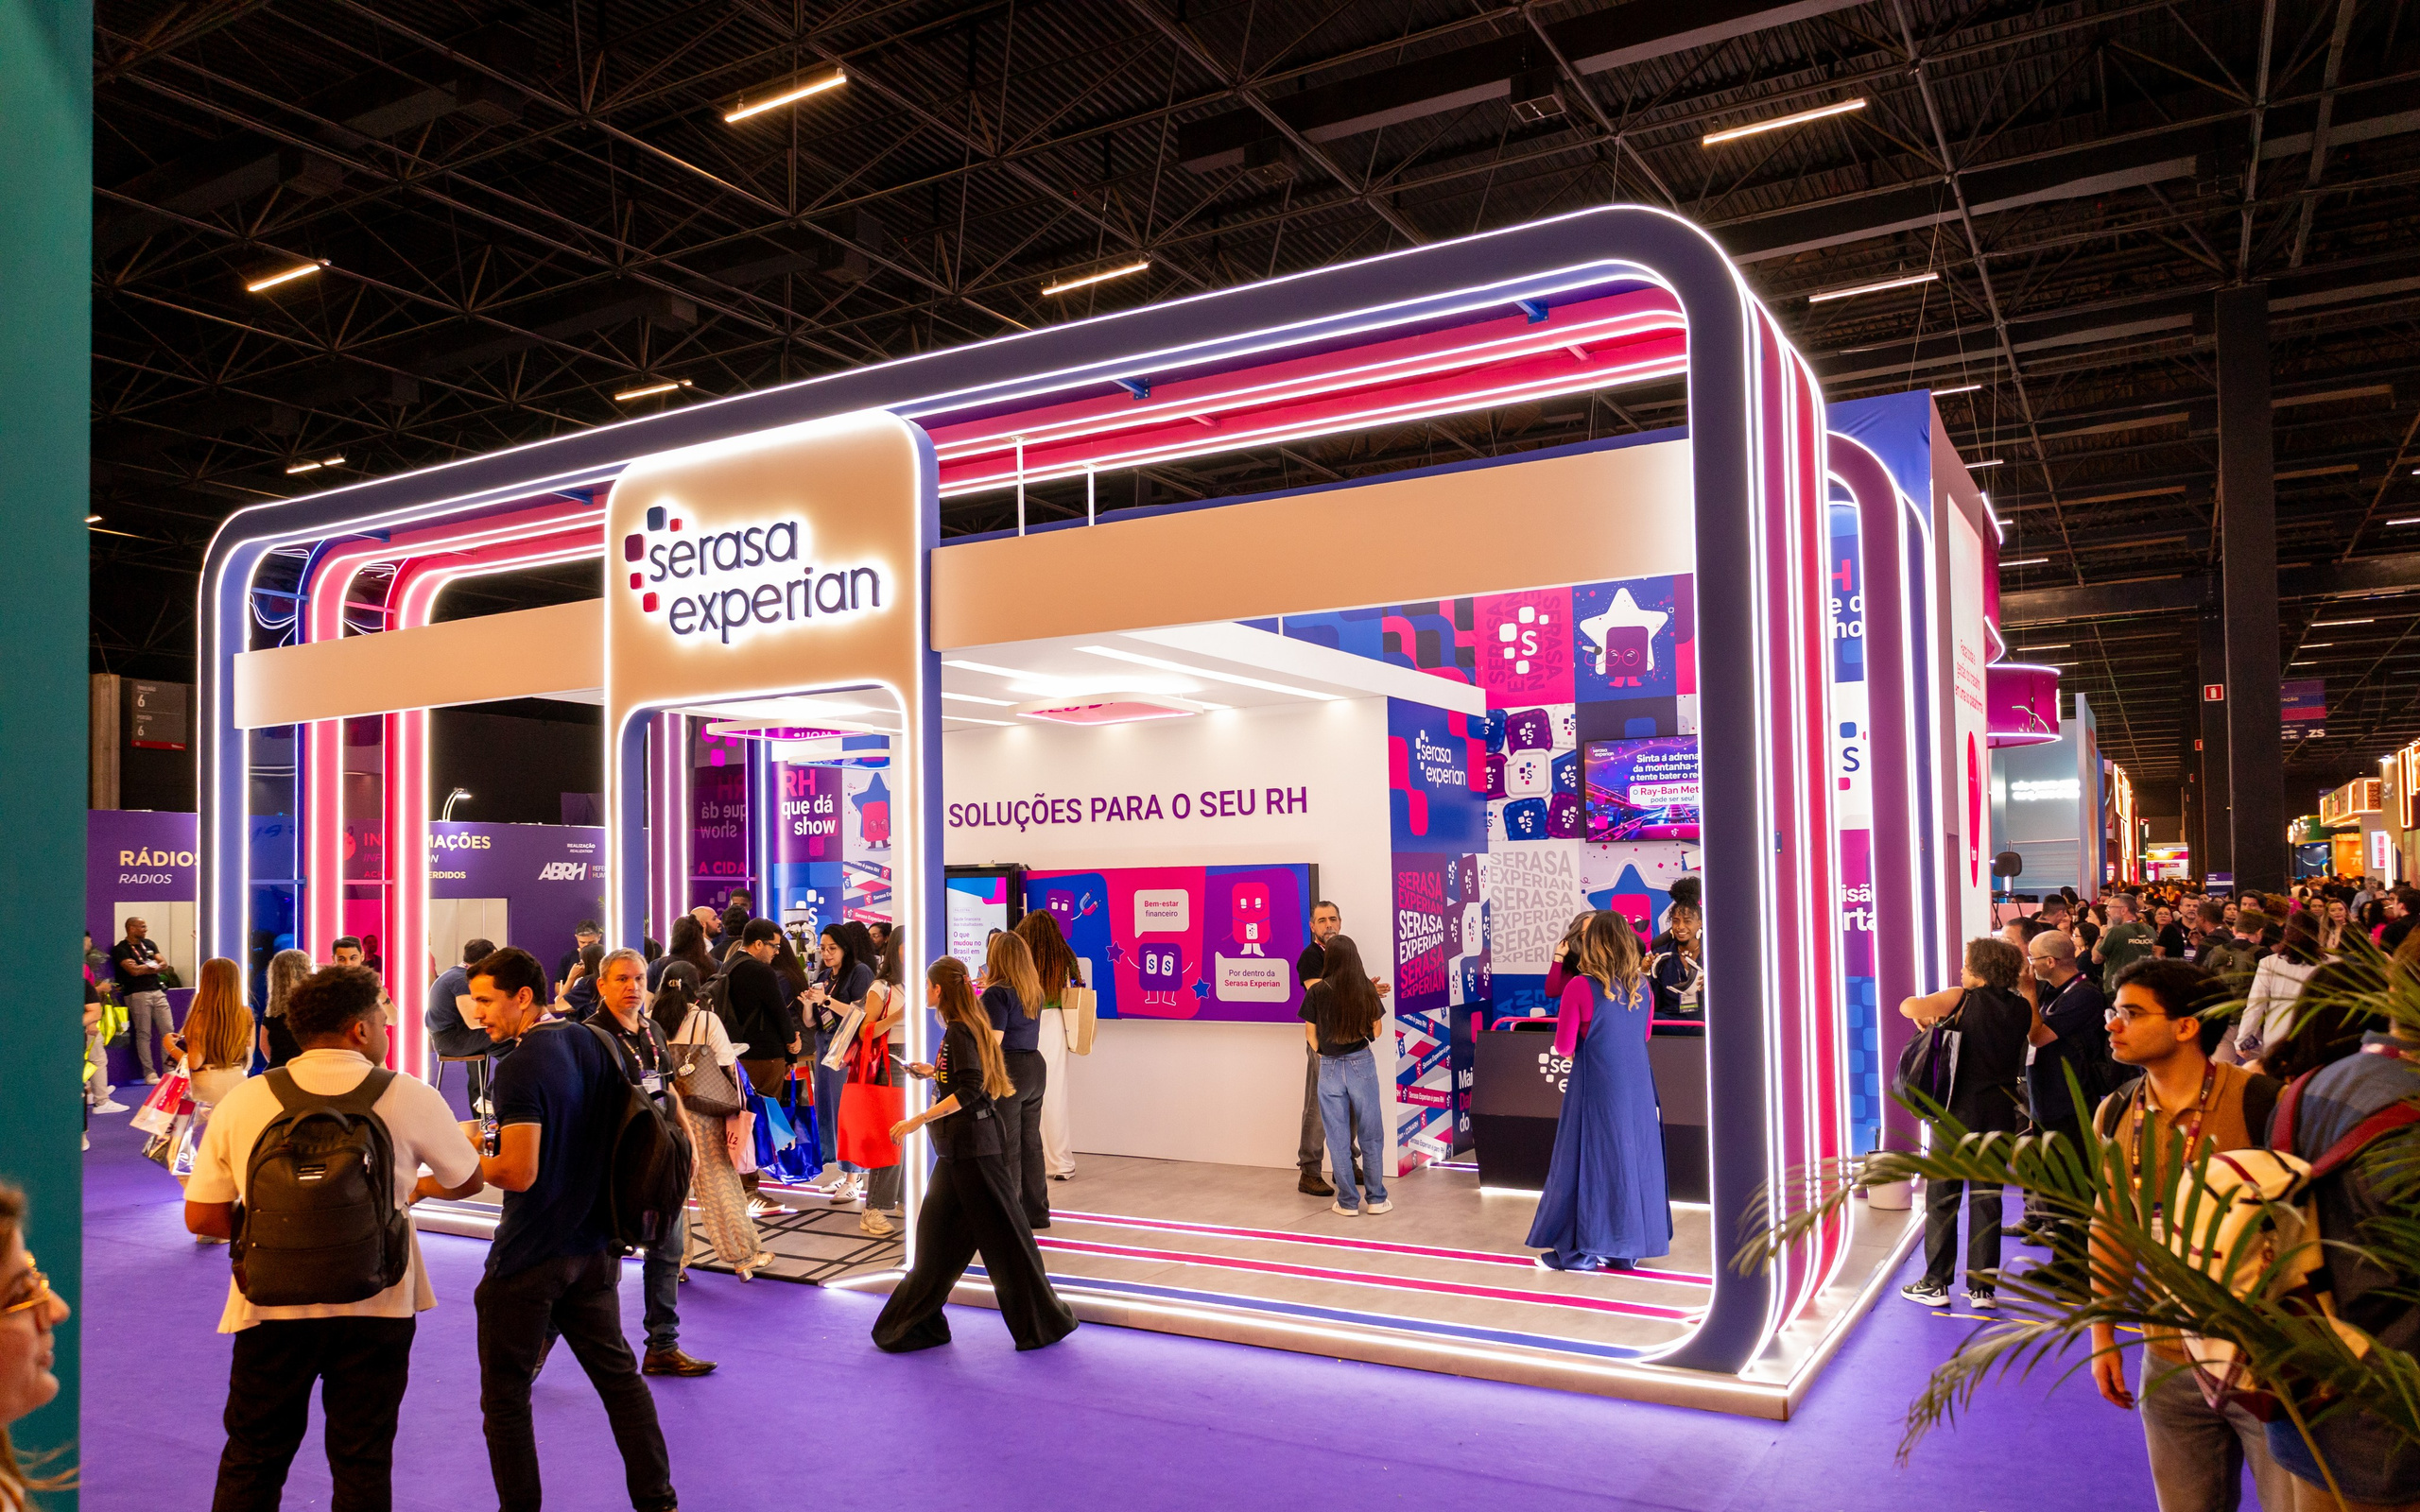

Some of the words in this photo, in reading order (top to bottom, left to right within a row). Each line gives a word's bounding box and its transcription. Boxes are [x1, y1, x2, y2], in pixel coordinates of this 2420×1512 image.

[649, 521, 798, 583] serasa
[669, 567, 880, 644] experian
[137, 694, 146, 708] 6
[137, 725, 145, 736] 6
[1421, 744, 1452, 764] serasa
[1636, 753, 1660, 764] Sinta
[1426, 765, 1466, 788] experian
[1633, 765, 1644, 773] da
[1659, 771, 1682, 781] bater
[783, 768, 816, 797] RH
[1640, 786, 1679, 797] Ray-Ban
[1681, 785, 1699, 794] Met
[781, 800, 811, 820] que
[814, 794, 834, 815] dá
[948, 792, 1082, 833] SOLUÇÕES
[1090, 795, 1165, 822] PARA
[1171, 793, 1191, 820] O
[1200, 789, 1256, 818] SEU
[1266, 786, 1307, 816] RH
[1651, 796, 1668, 804] pode
[794, 816, 836, 835] show
[119, 846, 197, 868] RÁDIO
[1490, 850, 1574, 879] SERASA
[118, 873, 173, 885] RADIOS
[428, 870, 467, 879] ERDIDOS
[537, 862, 587, 881] ABRH
[1489, 865, 1573, 891] EXPERIAN
[1398, 871, 1443, 902] SERASA
[1490, 885, 1574, 912] SERASA
[1398, 886, 1443, 915] EXPERIAN
[1399, 909, 1443, 940] SERASA
[1491, 907, 1574, 934] EXPERIAN
[1400, 932, 1444, 965] EXPERIAN
[1400, 944, 1444, 989] SERASA
[1250, 979, 1281, 988] Experian
[1401, 965, 1445, 999] EXPERIAN
